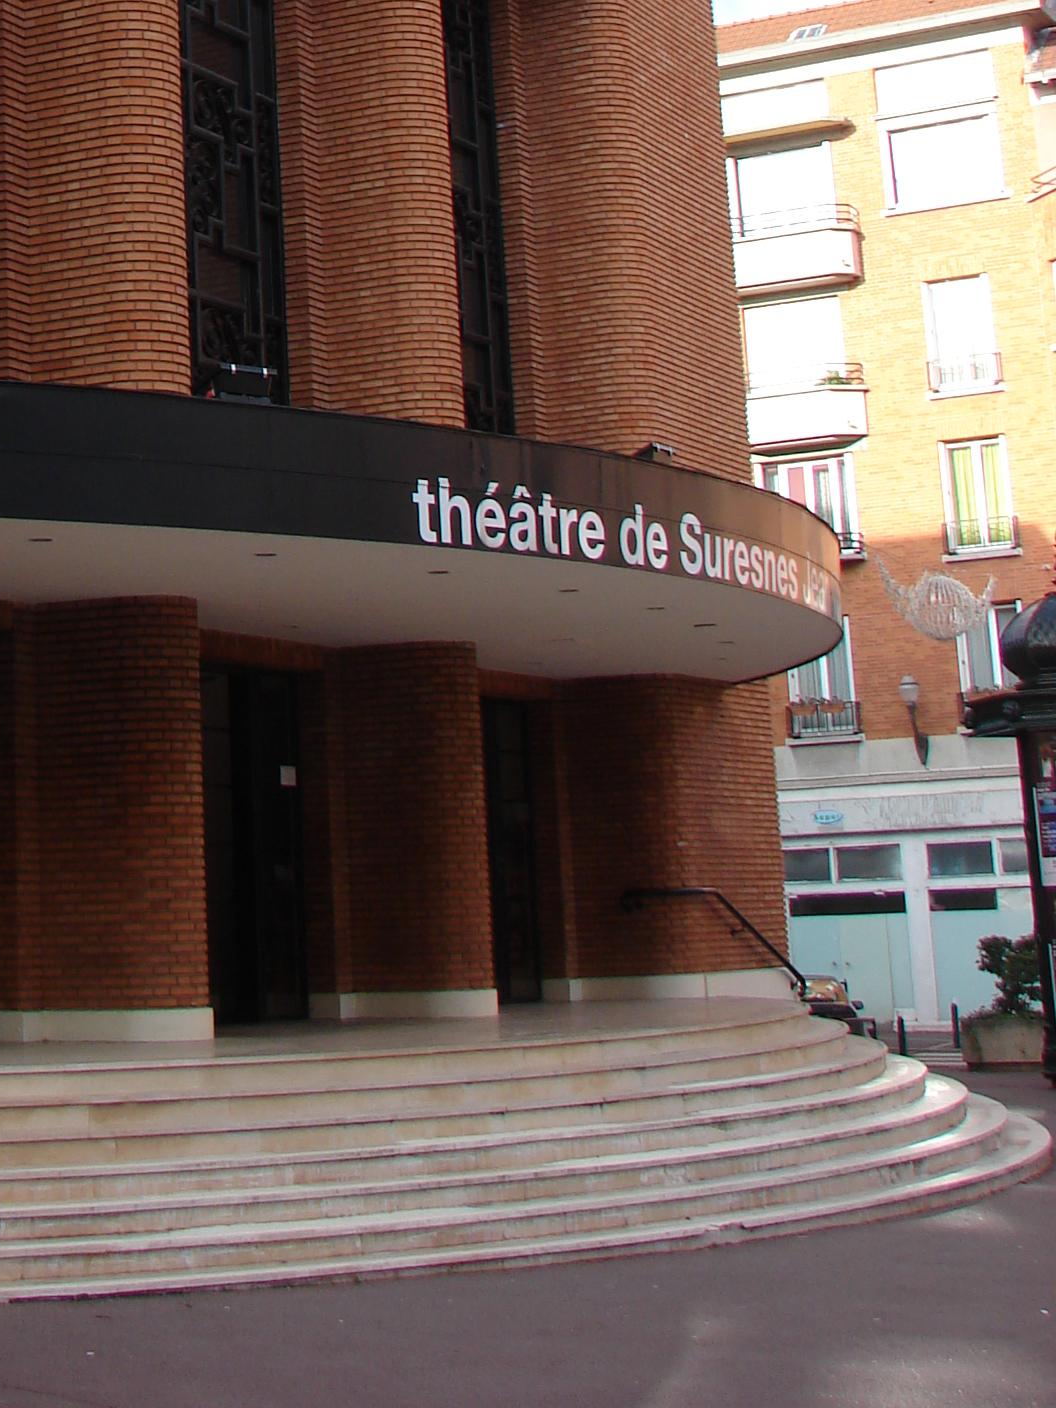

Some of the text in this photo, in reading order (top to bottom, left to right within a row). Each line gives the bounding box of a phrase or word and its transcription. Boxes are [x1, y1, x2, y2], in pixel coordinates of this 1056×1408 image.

[412, 477, 831, 613] théâtre de Suresnes Jea
